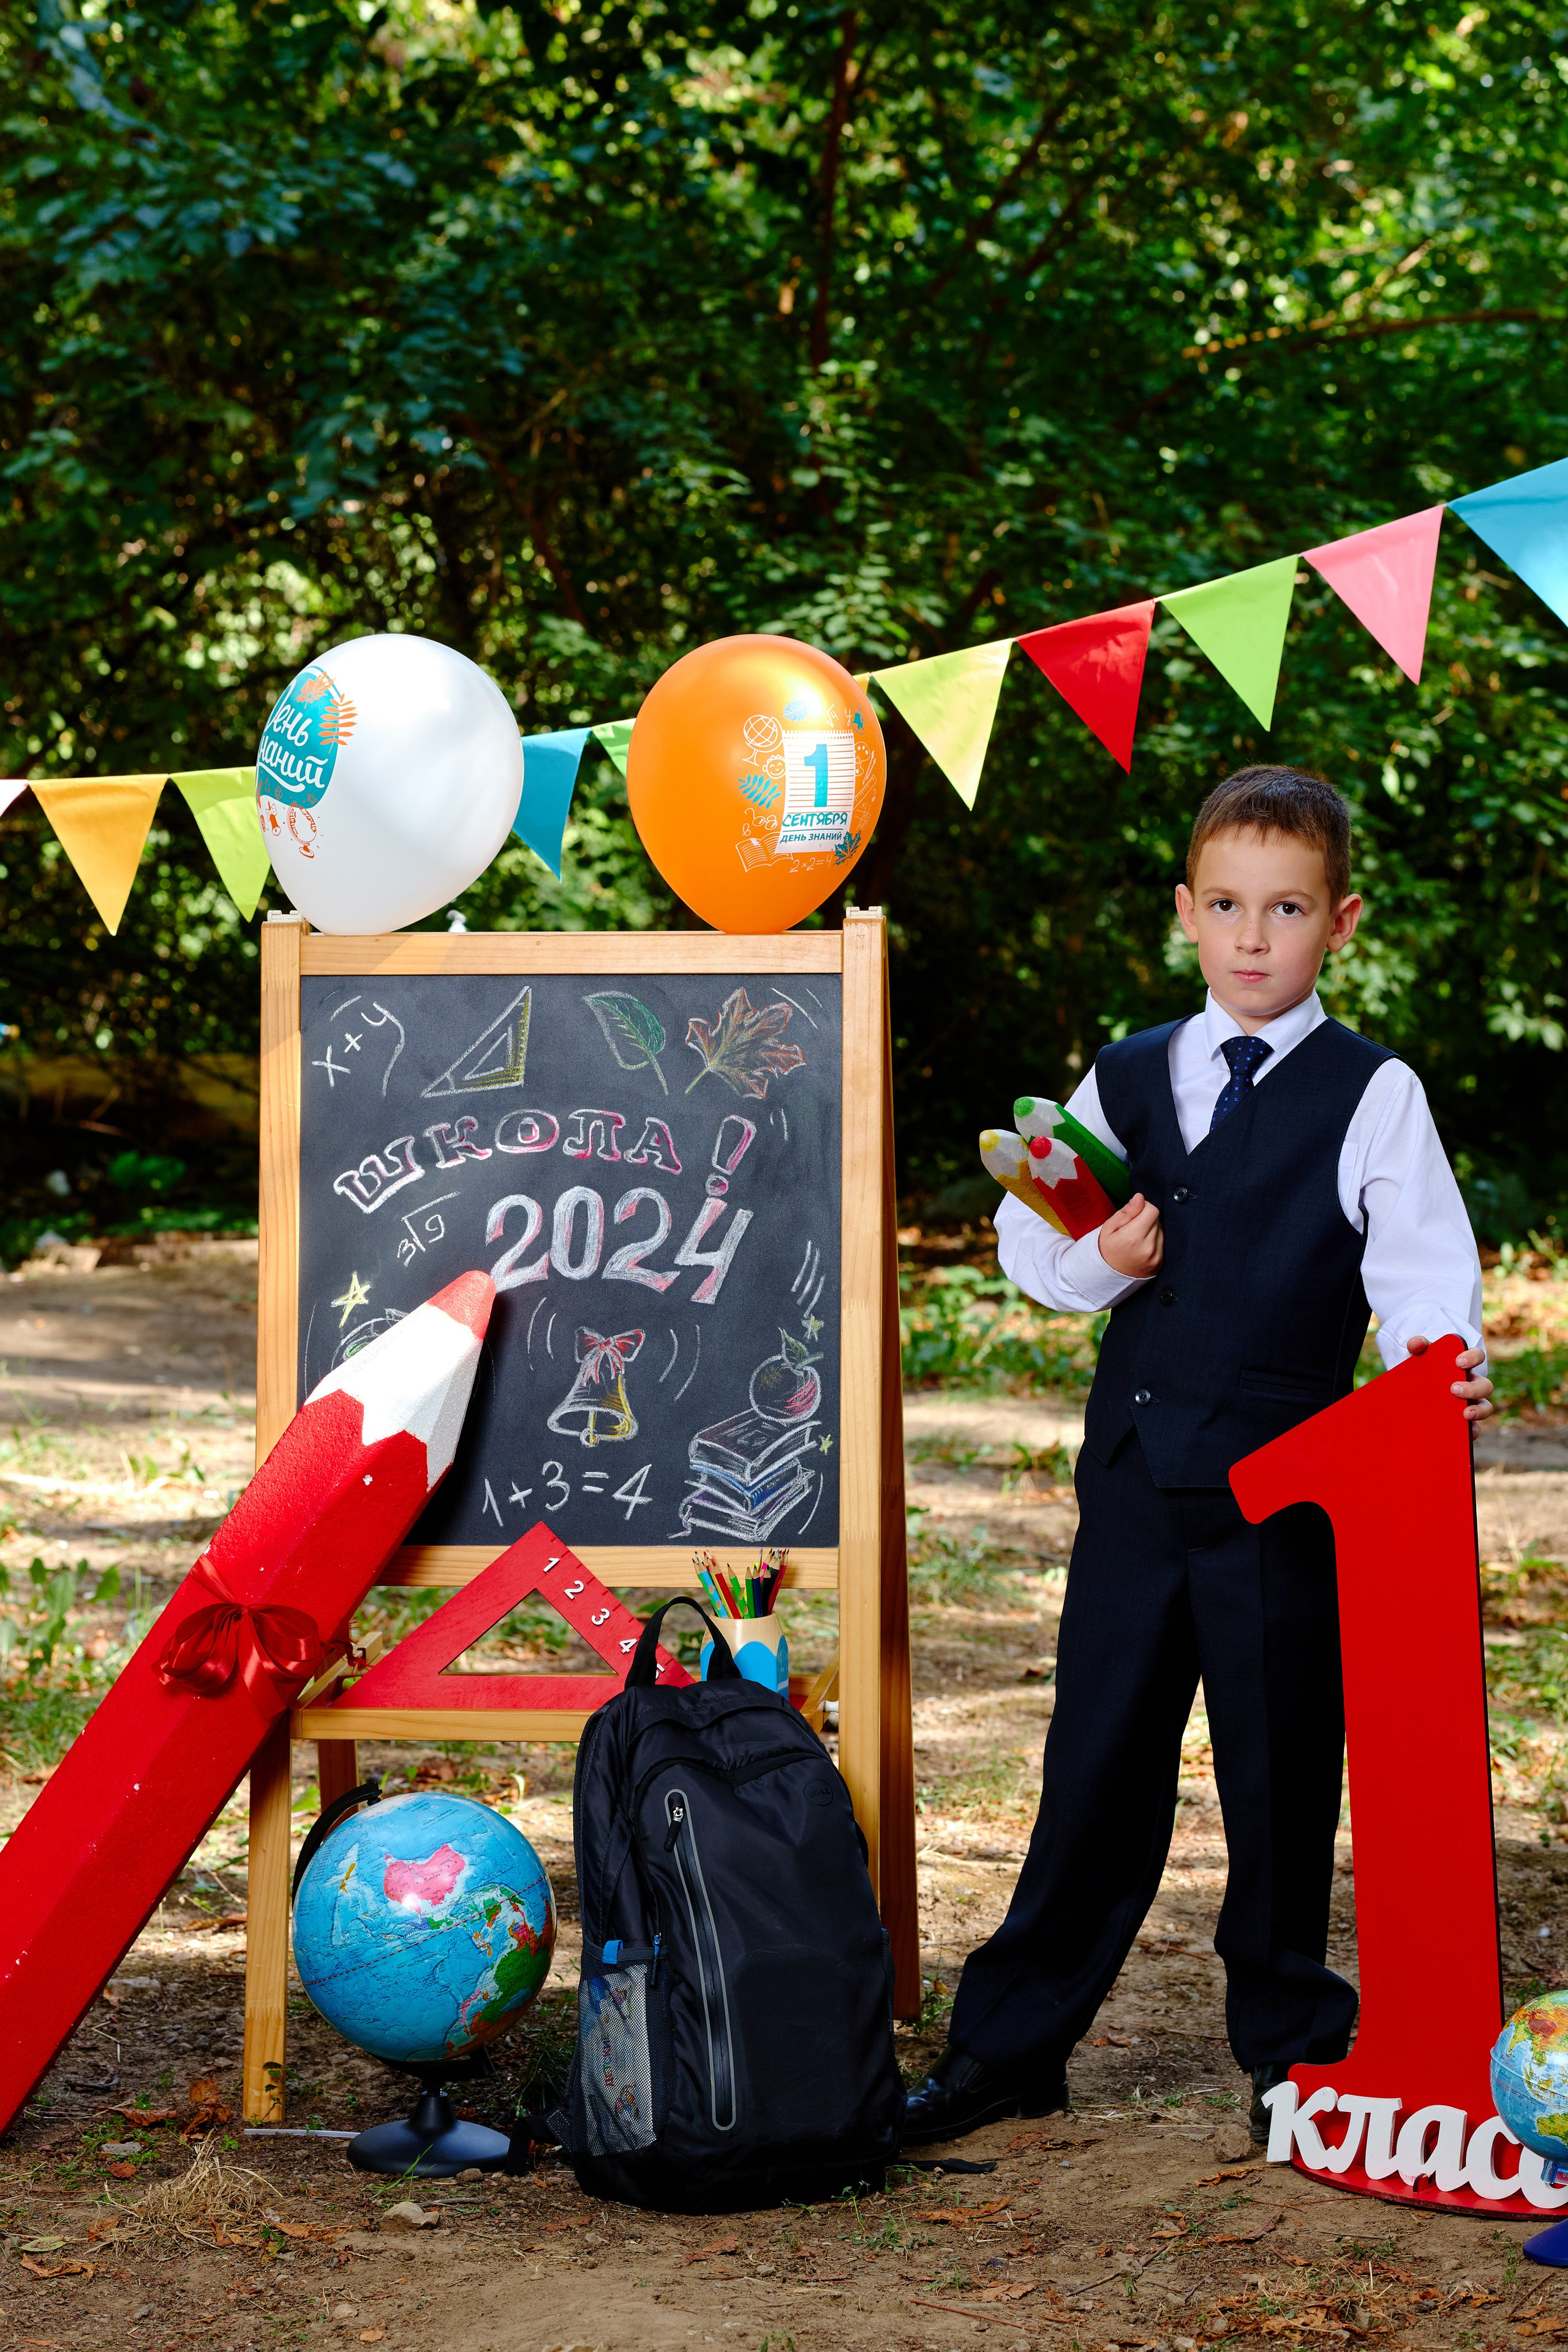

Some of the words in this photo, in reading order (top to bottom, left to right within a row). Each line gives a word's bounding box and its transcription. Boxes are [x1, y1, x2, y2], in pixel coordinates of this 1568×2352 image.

[257, 735, 325, 788] наний
[804, 744, 828, 807] 1
[779, 834, 807, 844] ДЕНЬ
[808, 831, 843, 841] ЗНАНИЙ
[782, 811, 848, 827] СЕНТЯБРЯ
[485, 1185, 755, 1305] 2024
[543, 1556, 561, 1574] 1
[564, 1580, 585, 1600] 2
[590, 1608, 611, 1626] 3
[618, 1637, 638, 1655] 4
[1229, 1333, 1537, 2168] 1
